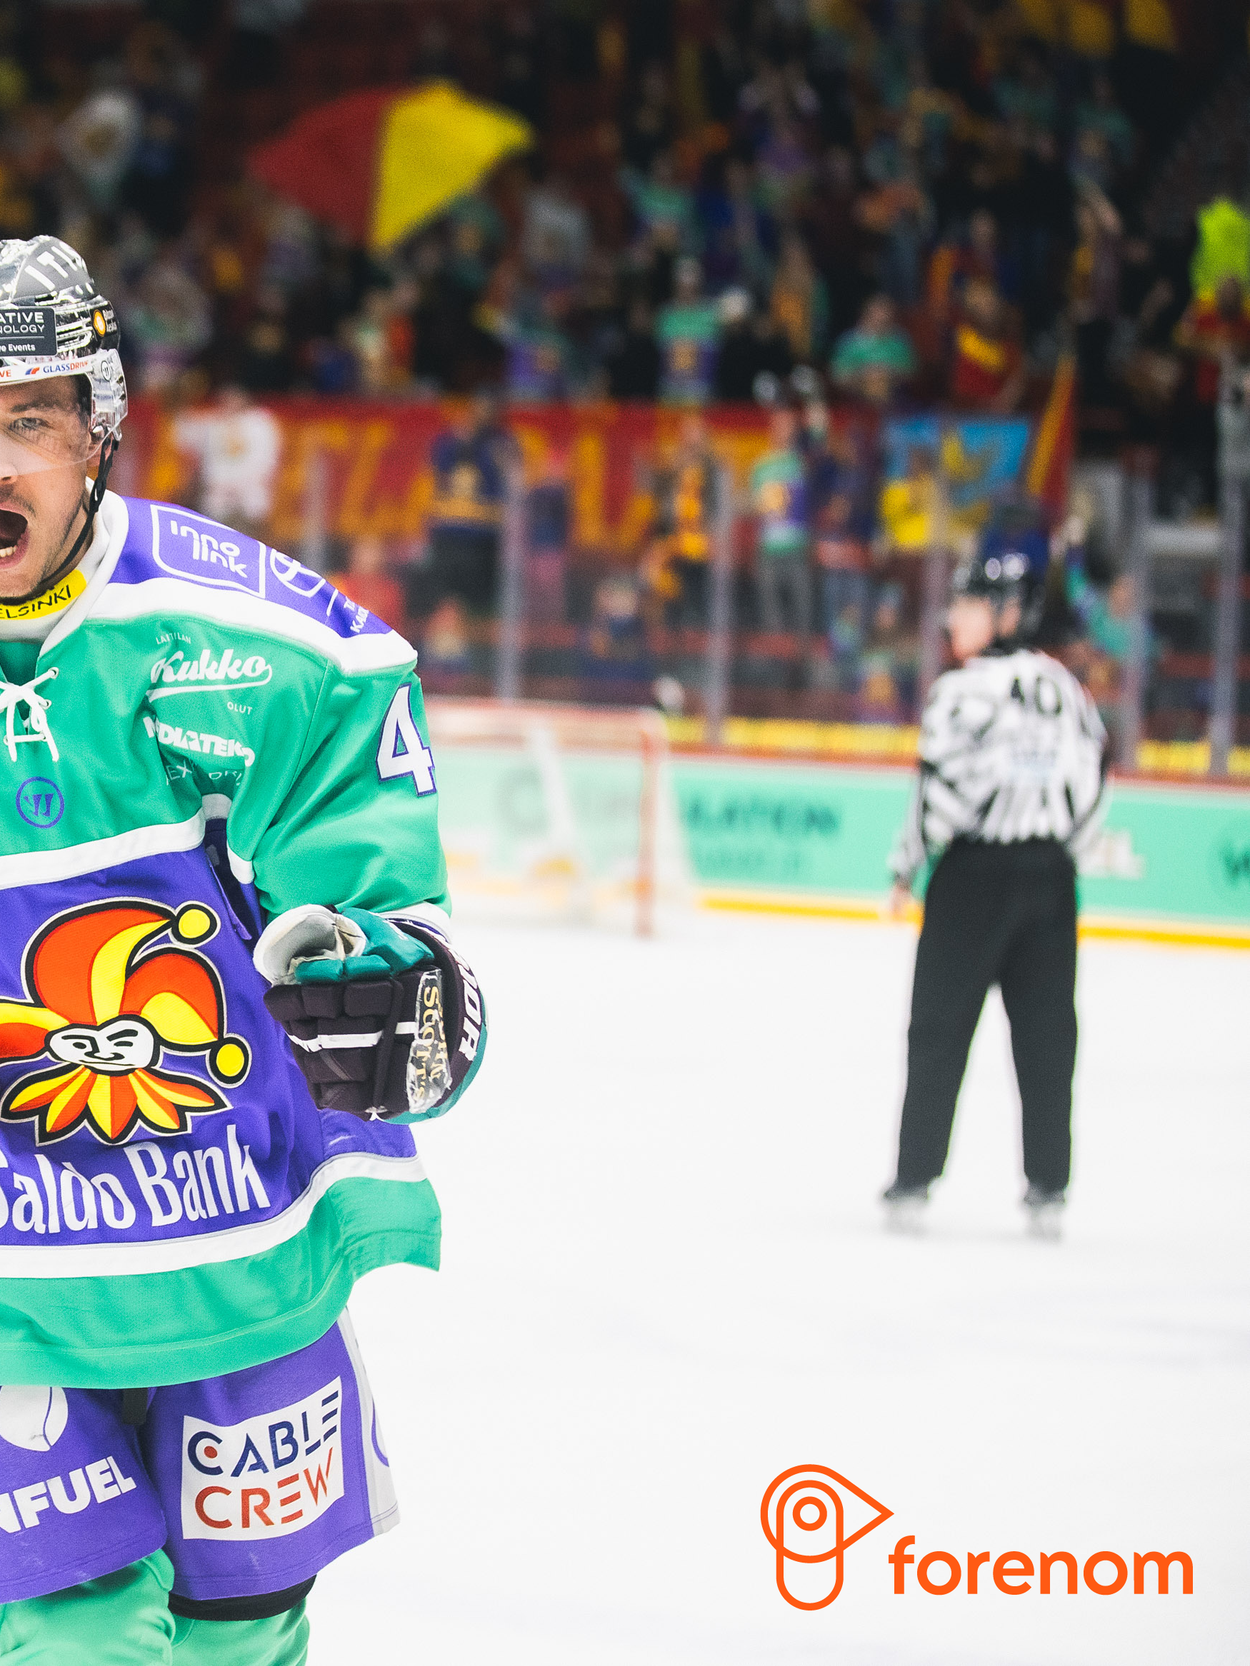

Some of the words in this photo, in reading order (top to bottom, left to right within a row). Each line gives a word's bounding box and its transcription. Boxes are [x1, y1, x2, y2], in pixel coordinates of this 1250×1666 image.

[8, 342, 36, 352] Events
[155, 631, 192, 645] LAITILAN
[150, 648, 272, 684] Kukko
[226, 701, 253, 715] OLUT
[1010, 674, 1064, 717] 40
[376, 682, 437, 797] 4
[122, 1124, 271, 1228] Bank
[187, 1389, 339, 1478] CABLE
[194, 1446, 334, 1530] CREW
